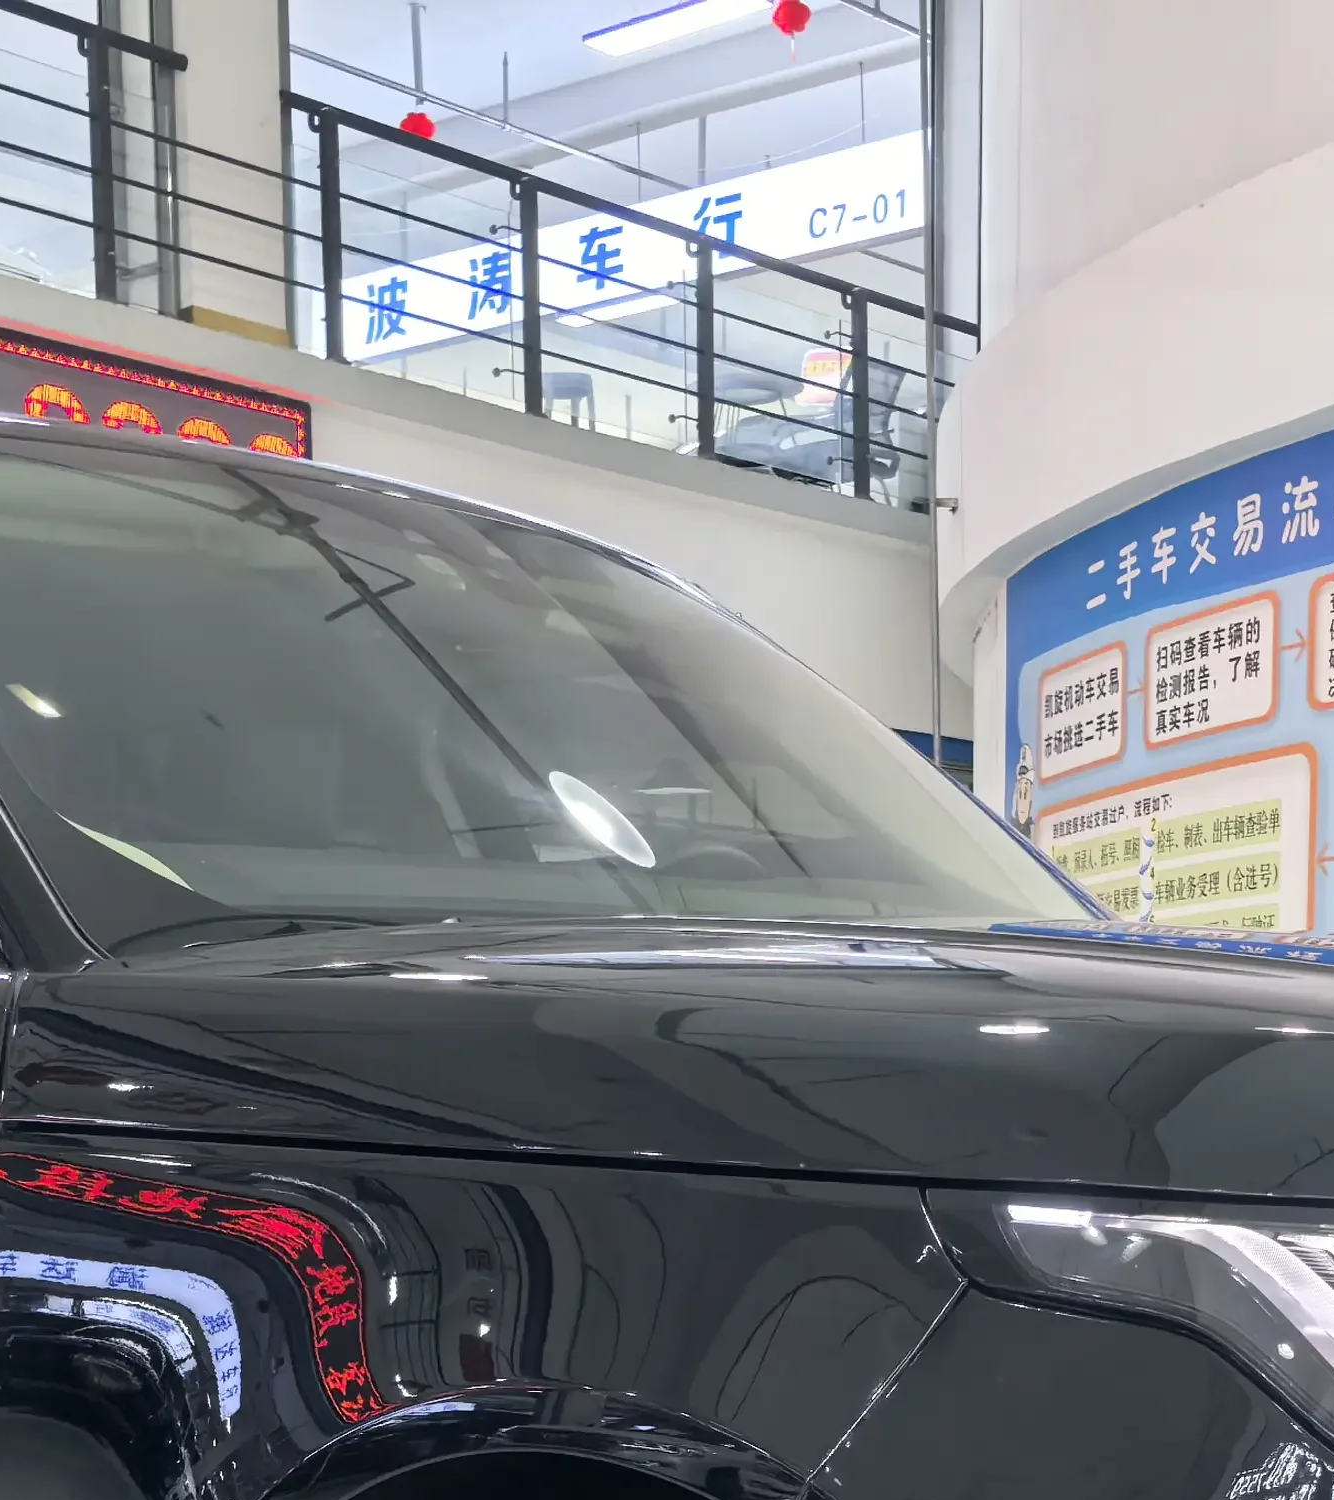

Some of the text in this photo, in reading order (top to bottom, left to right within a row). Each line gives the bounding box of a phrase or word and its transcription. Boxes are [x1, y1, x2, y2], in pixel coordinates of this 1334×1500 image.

[808, 189, 908, 241] C7-01
[364, 192, 744, 346] 波涛车行
[1155, 616, 1261, 673] 扫码查看车辆的
[1043, 667, 1120, 719] 凯旋机动车交易
[1155, 651, 1261, 705] 检测报告，了解
[1043, 709, 1120, 759] 市场挑选二手车
[1155, 698, 1210, 737] 真实车况
[1150, 817, 1158, 832] 2
